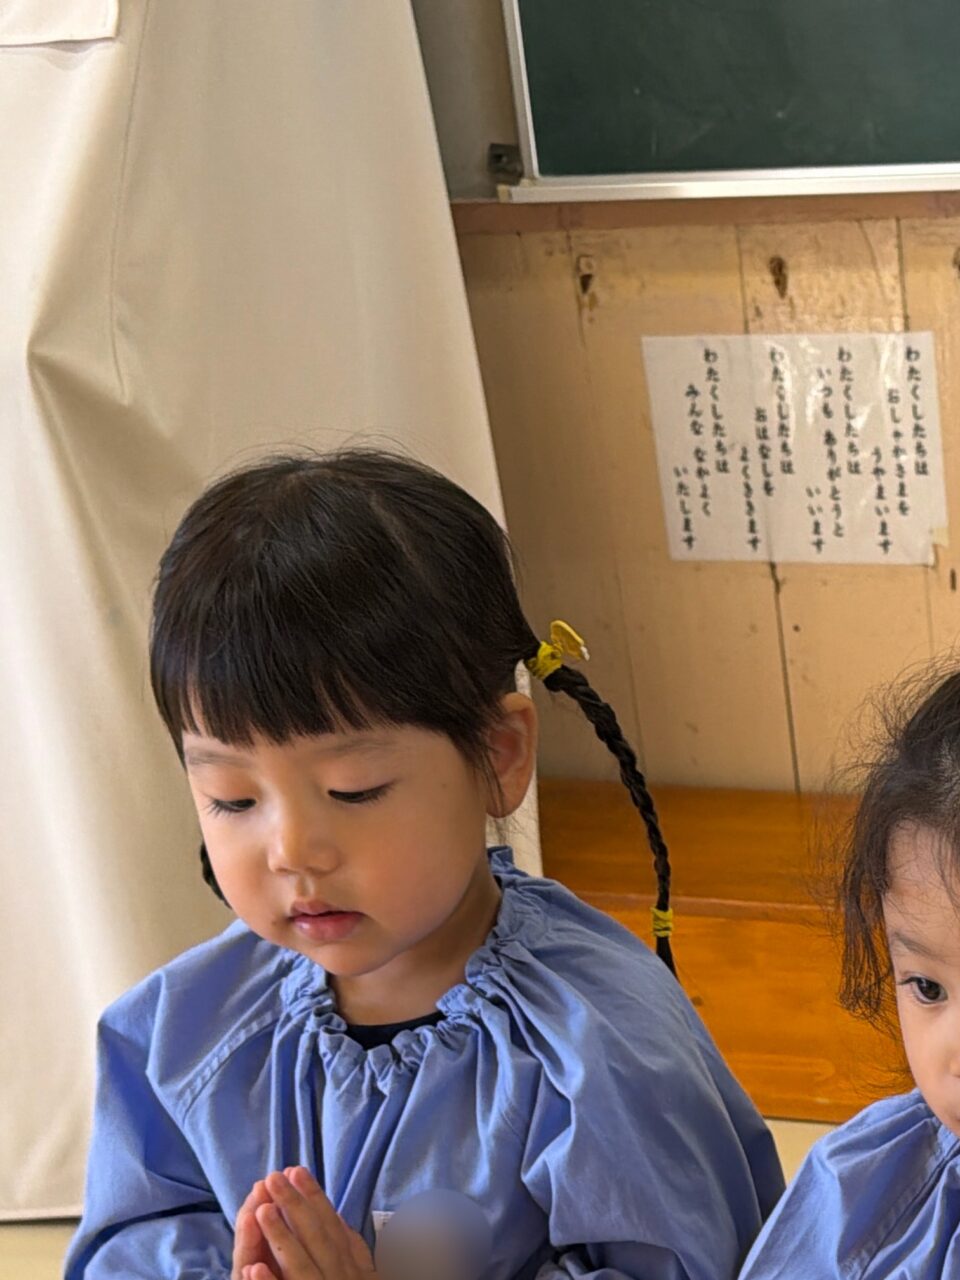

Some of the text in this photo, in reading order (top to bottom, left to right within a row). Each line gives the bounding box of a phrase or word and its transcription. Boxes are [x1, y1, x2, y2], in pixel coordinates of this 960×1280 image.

[704, 347, 729, 474] わたくしたちは
[755, 407, 774, 496] おはなしを
[770, 346, 795, 475] わたくしたちは
[838, 346, 860, 475] わたくしたちは
[888, 388, 910, 516] おしゃかさまを
[905, 346, 929, 475] わたくしたちは
[674, 466, 695, 550] いたします
[739, 446, 761, 552] よくききます
[806, 486, 825, 554] いいます
[872, 447, 893, 554] うやまいます
